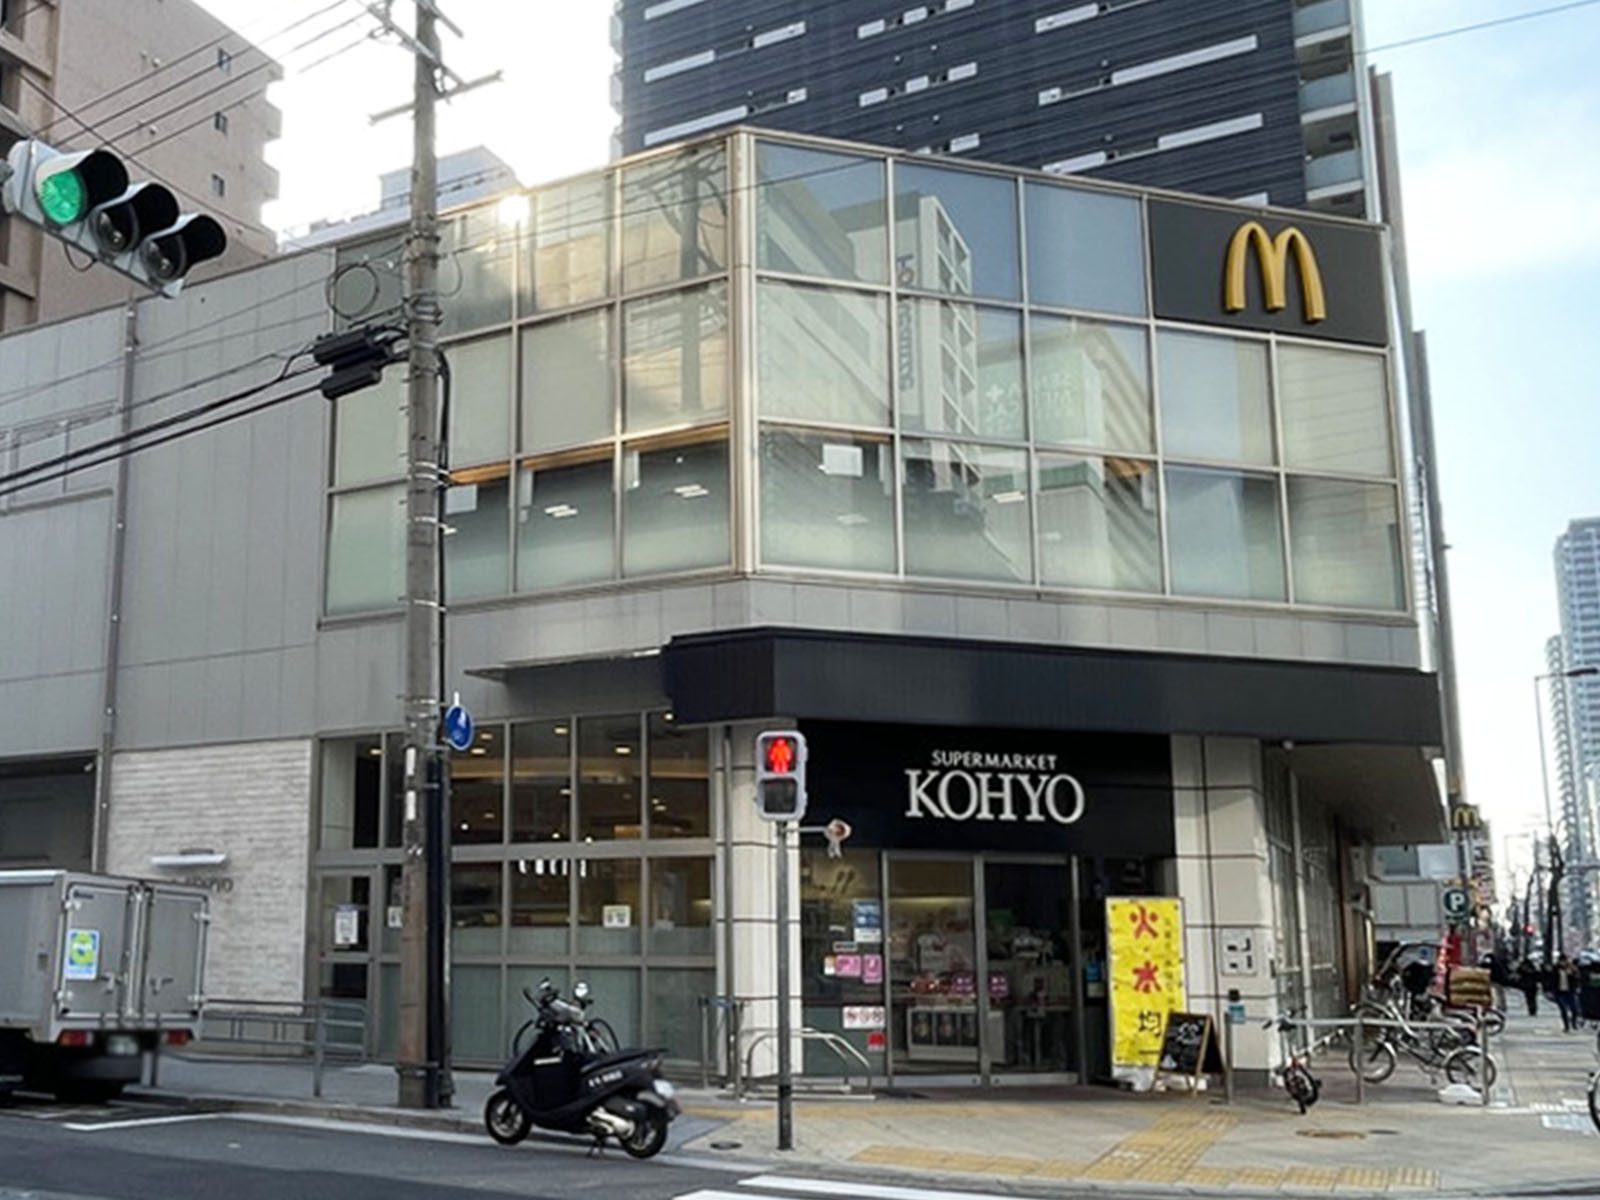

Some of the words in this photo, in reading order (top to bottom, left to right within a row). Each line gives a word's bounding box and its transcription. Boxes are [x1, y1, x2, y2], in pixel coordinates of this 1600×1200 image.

[931, 748, 1057, 771] SUPERMARKET
[904, 768, 1085, 824] KOHYO
[1450, 893, 1465, 911] P
